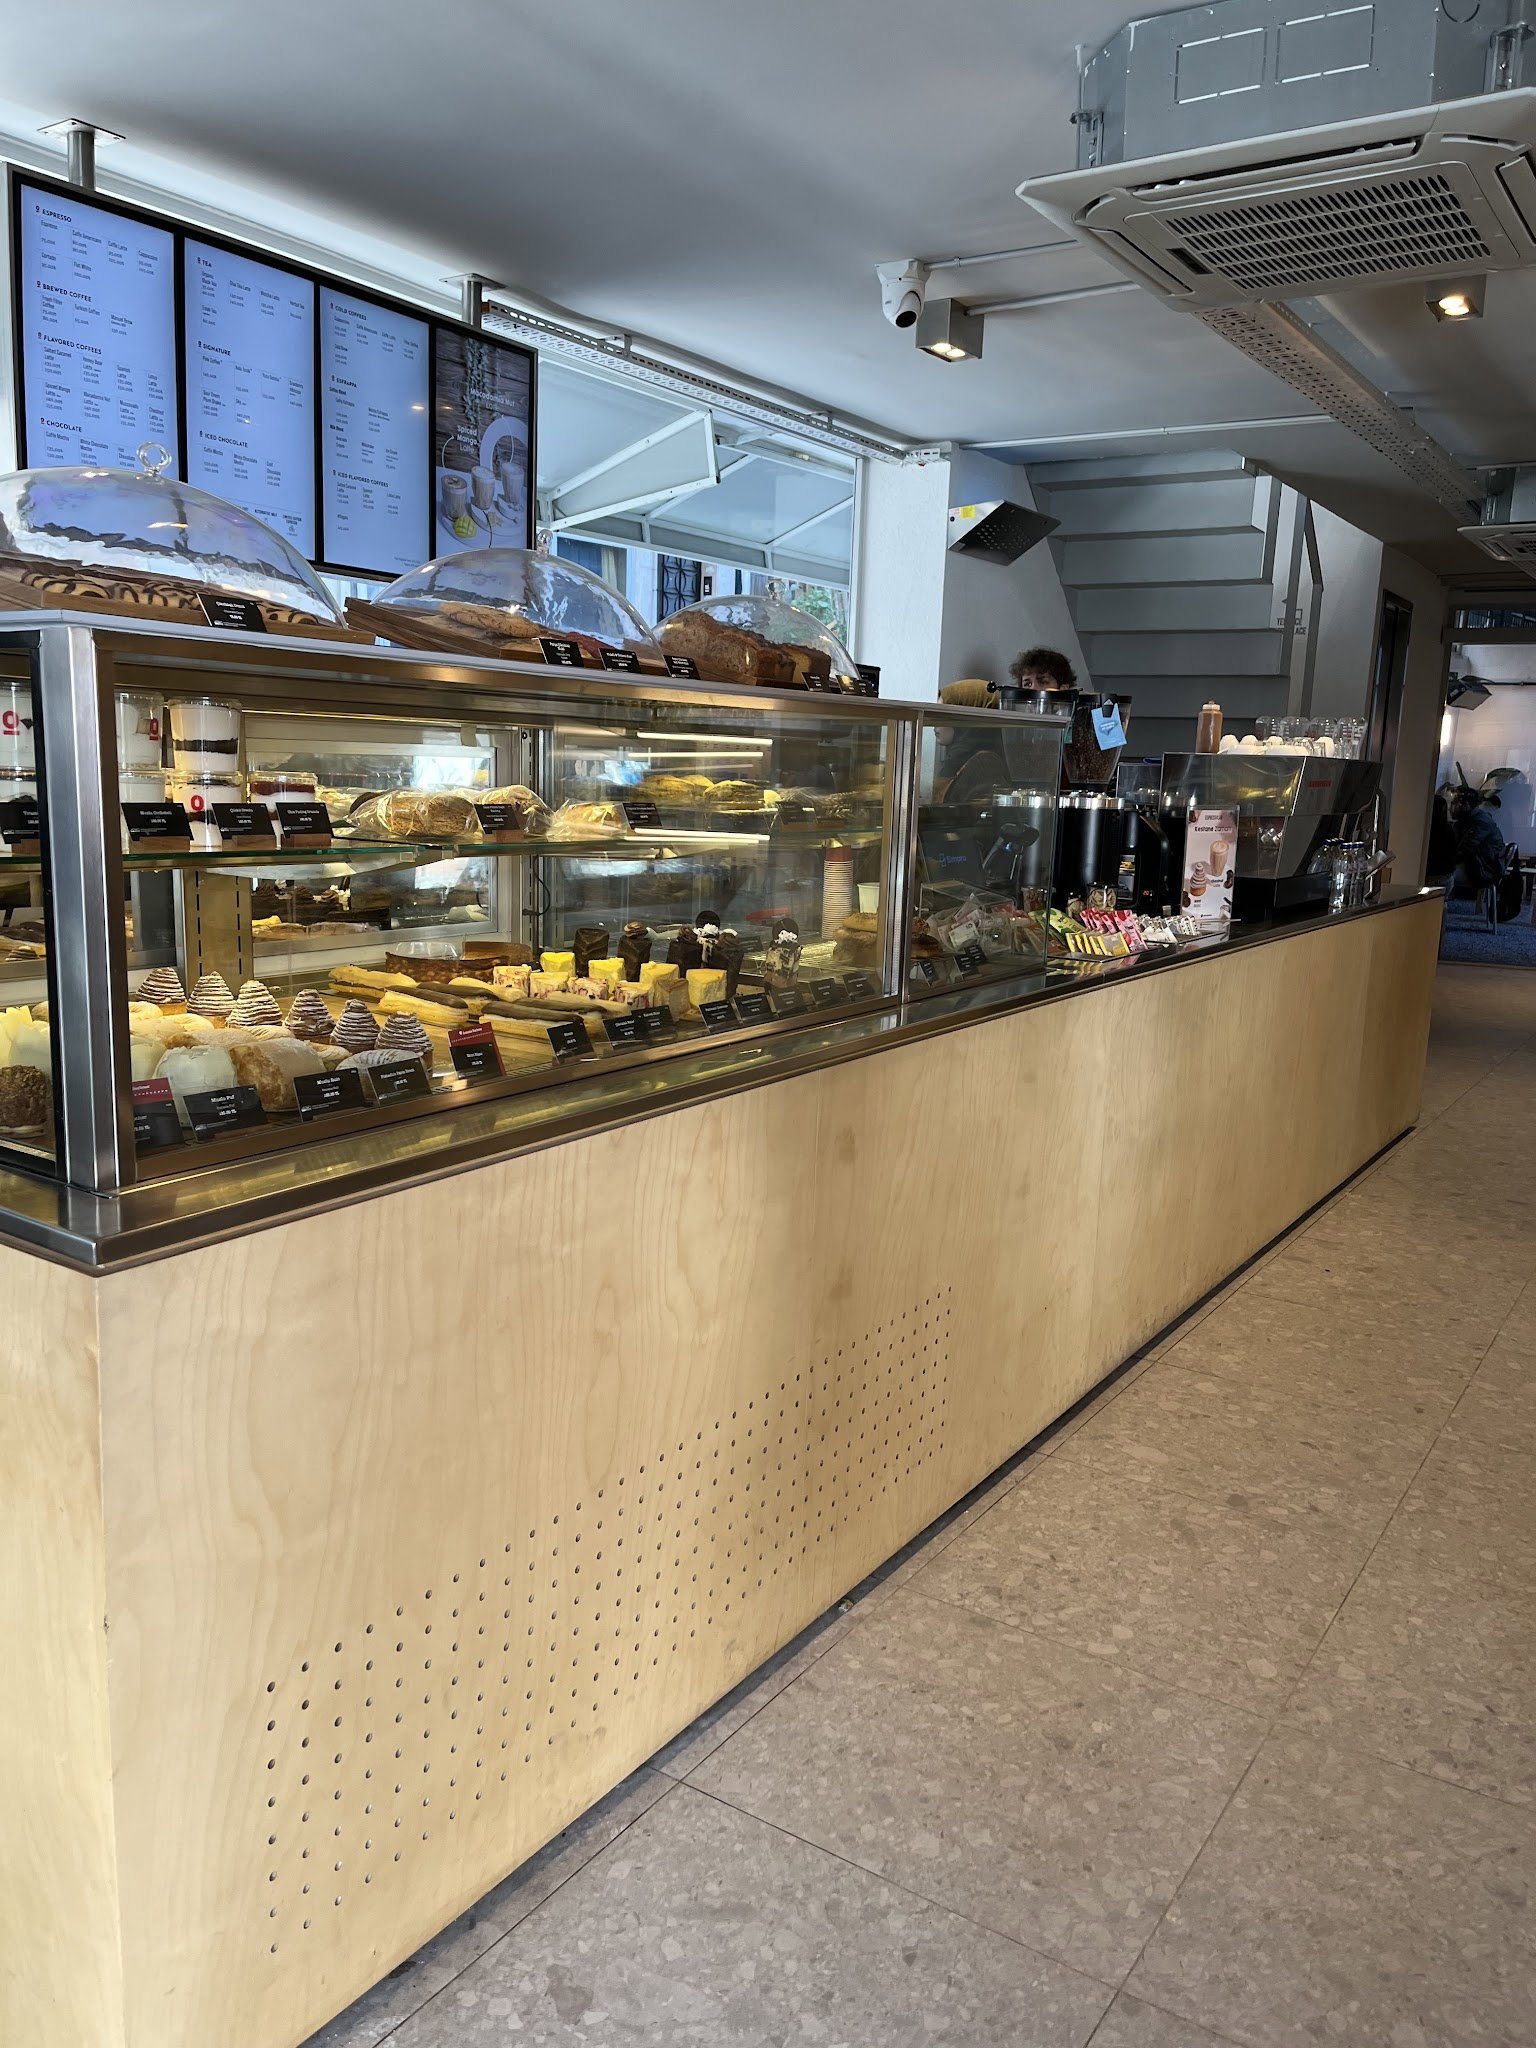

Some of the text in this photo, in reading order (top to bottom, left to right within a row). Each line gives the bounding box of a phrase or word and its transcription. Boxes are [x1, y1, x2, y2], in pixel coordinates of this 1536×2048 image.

[42, 209, 72, 222] ESPRESSO
[42, 283, 92, 302] BREWED COFFEE
[335, 306, 367, 321] COLD COFFEES
[43, 335, 102, 355] FLAVORED COFFEES
[203, 343, 231, 356] SIGNATURE
[470, 388, 515, 407] Macadamia Nut
[46, 420, 82, 433] CHOCOLATE
[457, 424, 477, 436] Spiced
[204, 433, 248, 448] ICED CHOCOLATE
[457, 434, 477, 445] Mango
[348, 474, 370, 484] FLAVORED
[370, 479, 389, 488] COFFEES
